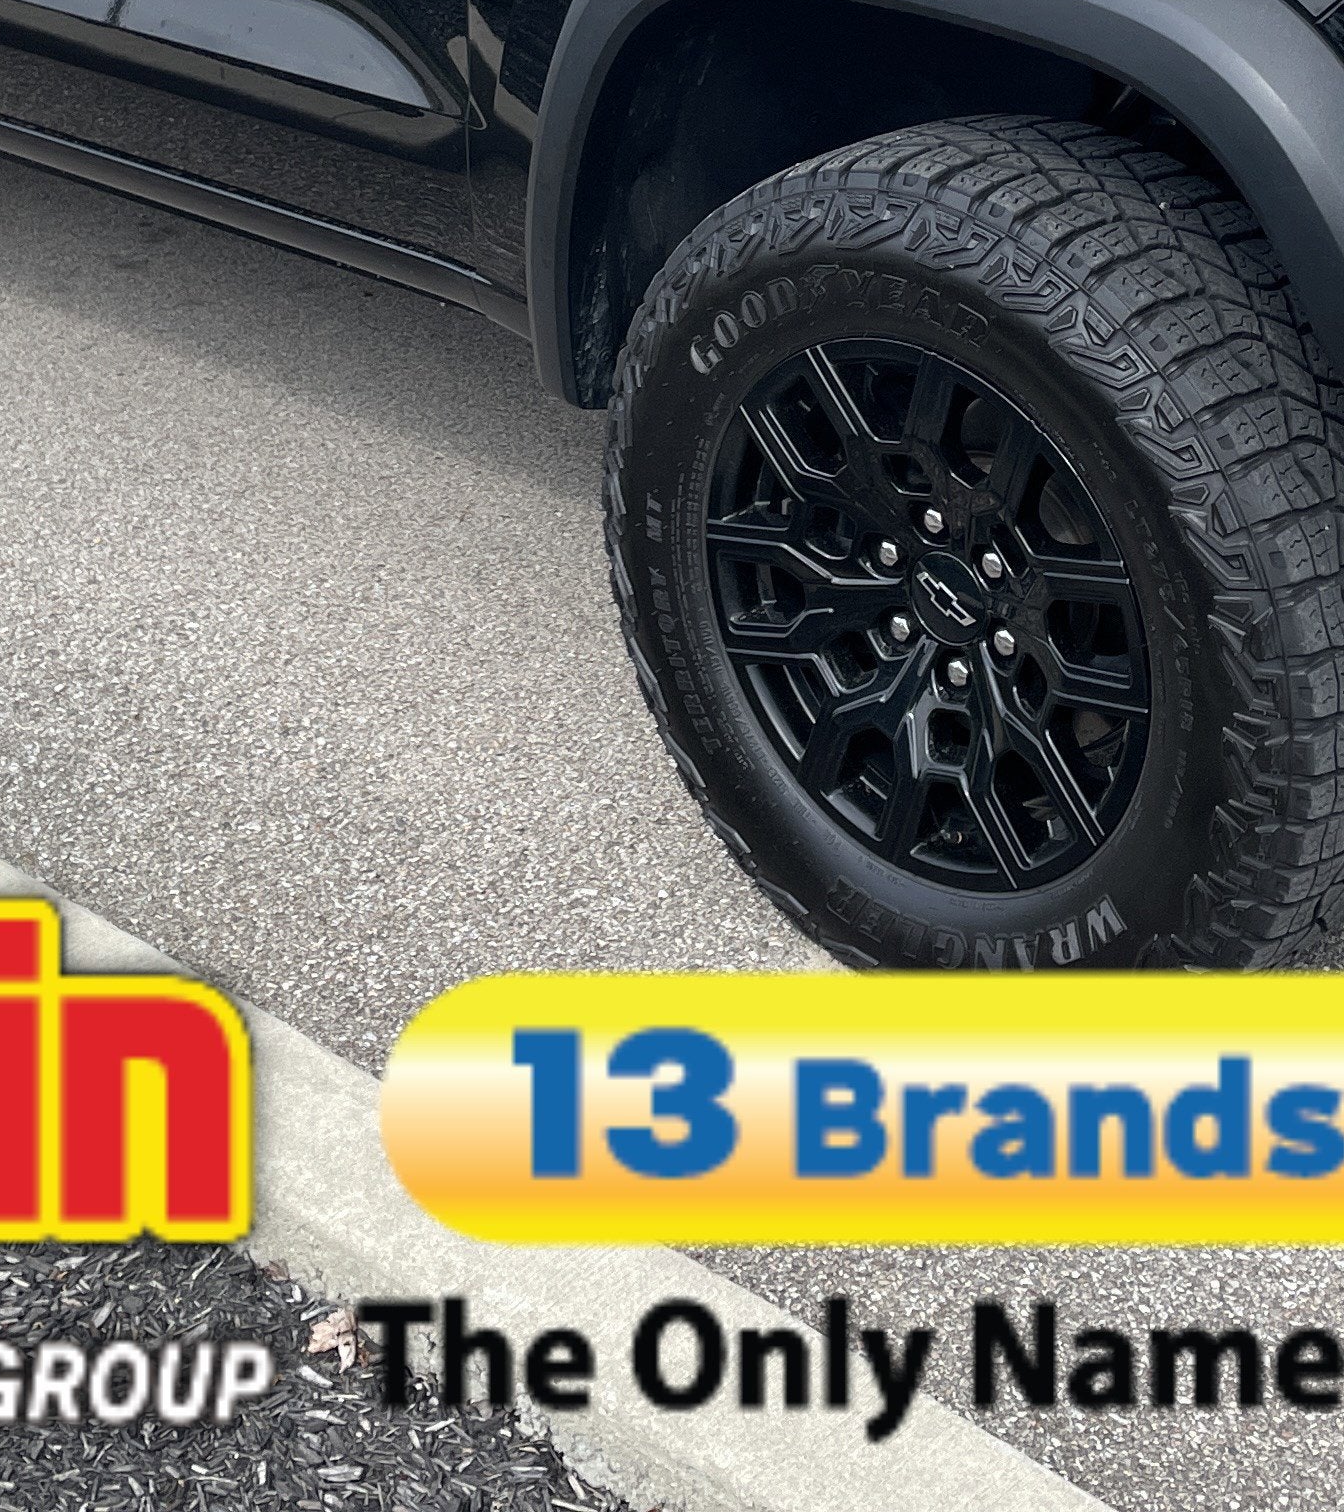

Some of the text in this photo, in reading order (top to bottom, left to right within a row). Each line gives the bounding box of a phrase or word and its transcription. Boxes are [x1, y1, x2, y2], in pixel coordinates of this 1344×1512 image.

[689, 264, 990, 375] GOODYEAR
[648, 565, 721, 755] TERRITORY
[826, 875, 1129, 972] WRANGLER
